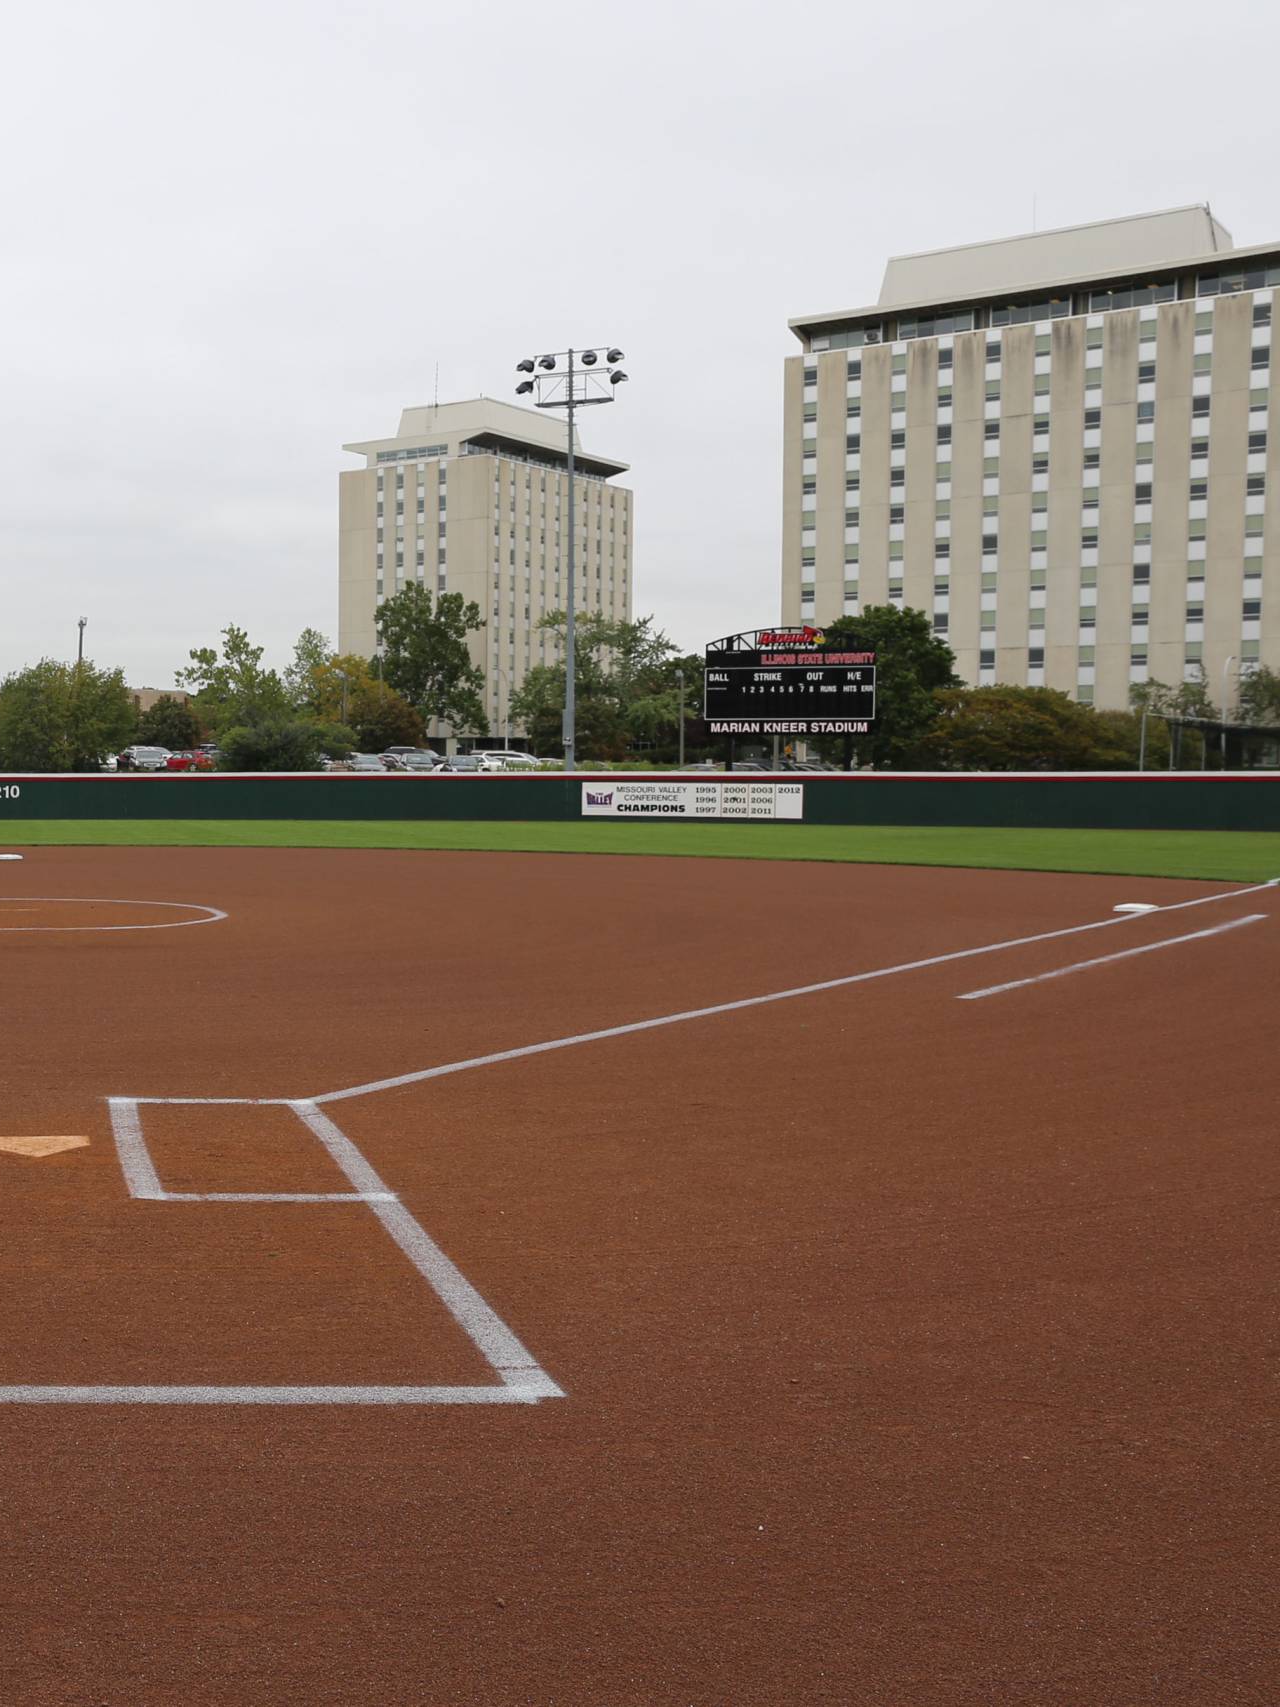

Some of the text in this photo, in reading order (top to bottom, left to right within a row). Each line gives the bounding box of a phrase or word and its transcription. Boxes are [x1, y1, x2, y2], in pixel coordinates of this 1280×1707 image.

[798, 653, 823, 664] STATE
[709, 673, 729, 682] BALL
[754, 673, 782, 681] STRIKE
[807, 672, 824, 681] OUT
[847, 672, 862, 680] H/E
[711, 722, 868, 733] MARIAN KNEER STADIUM
[617, 804, 685, 812] CHAMPIONS
